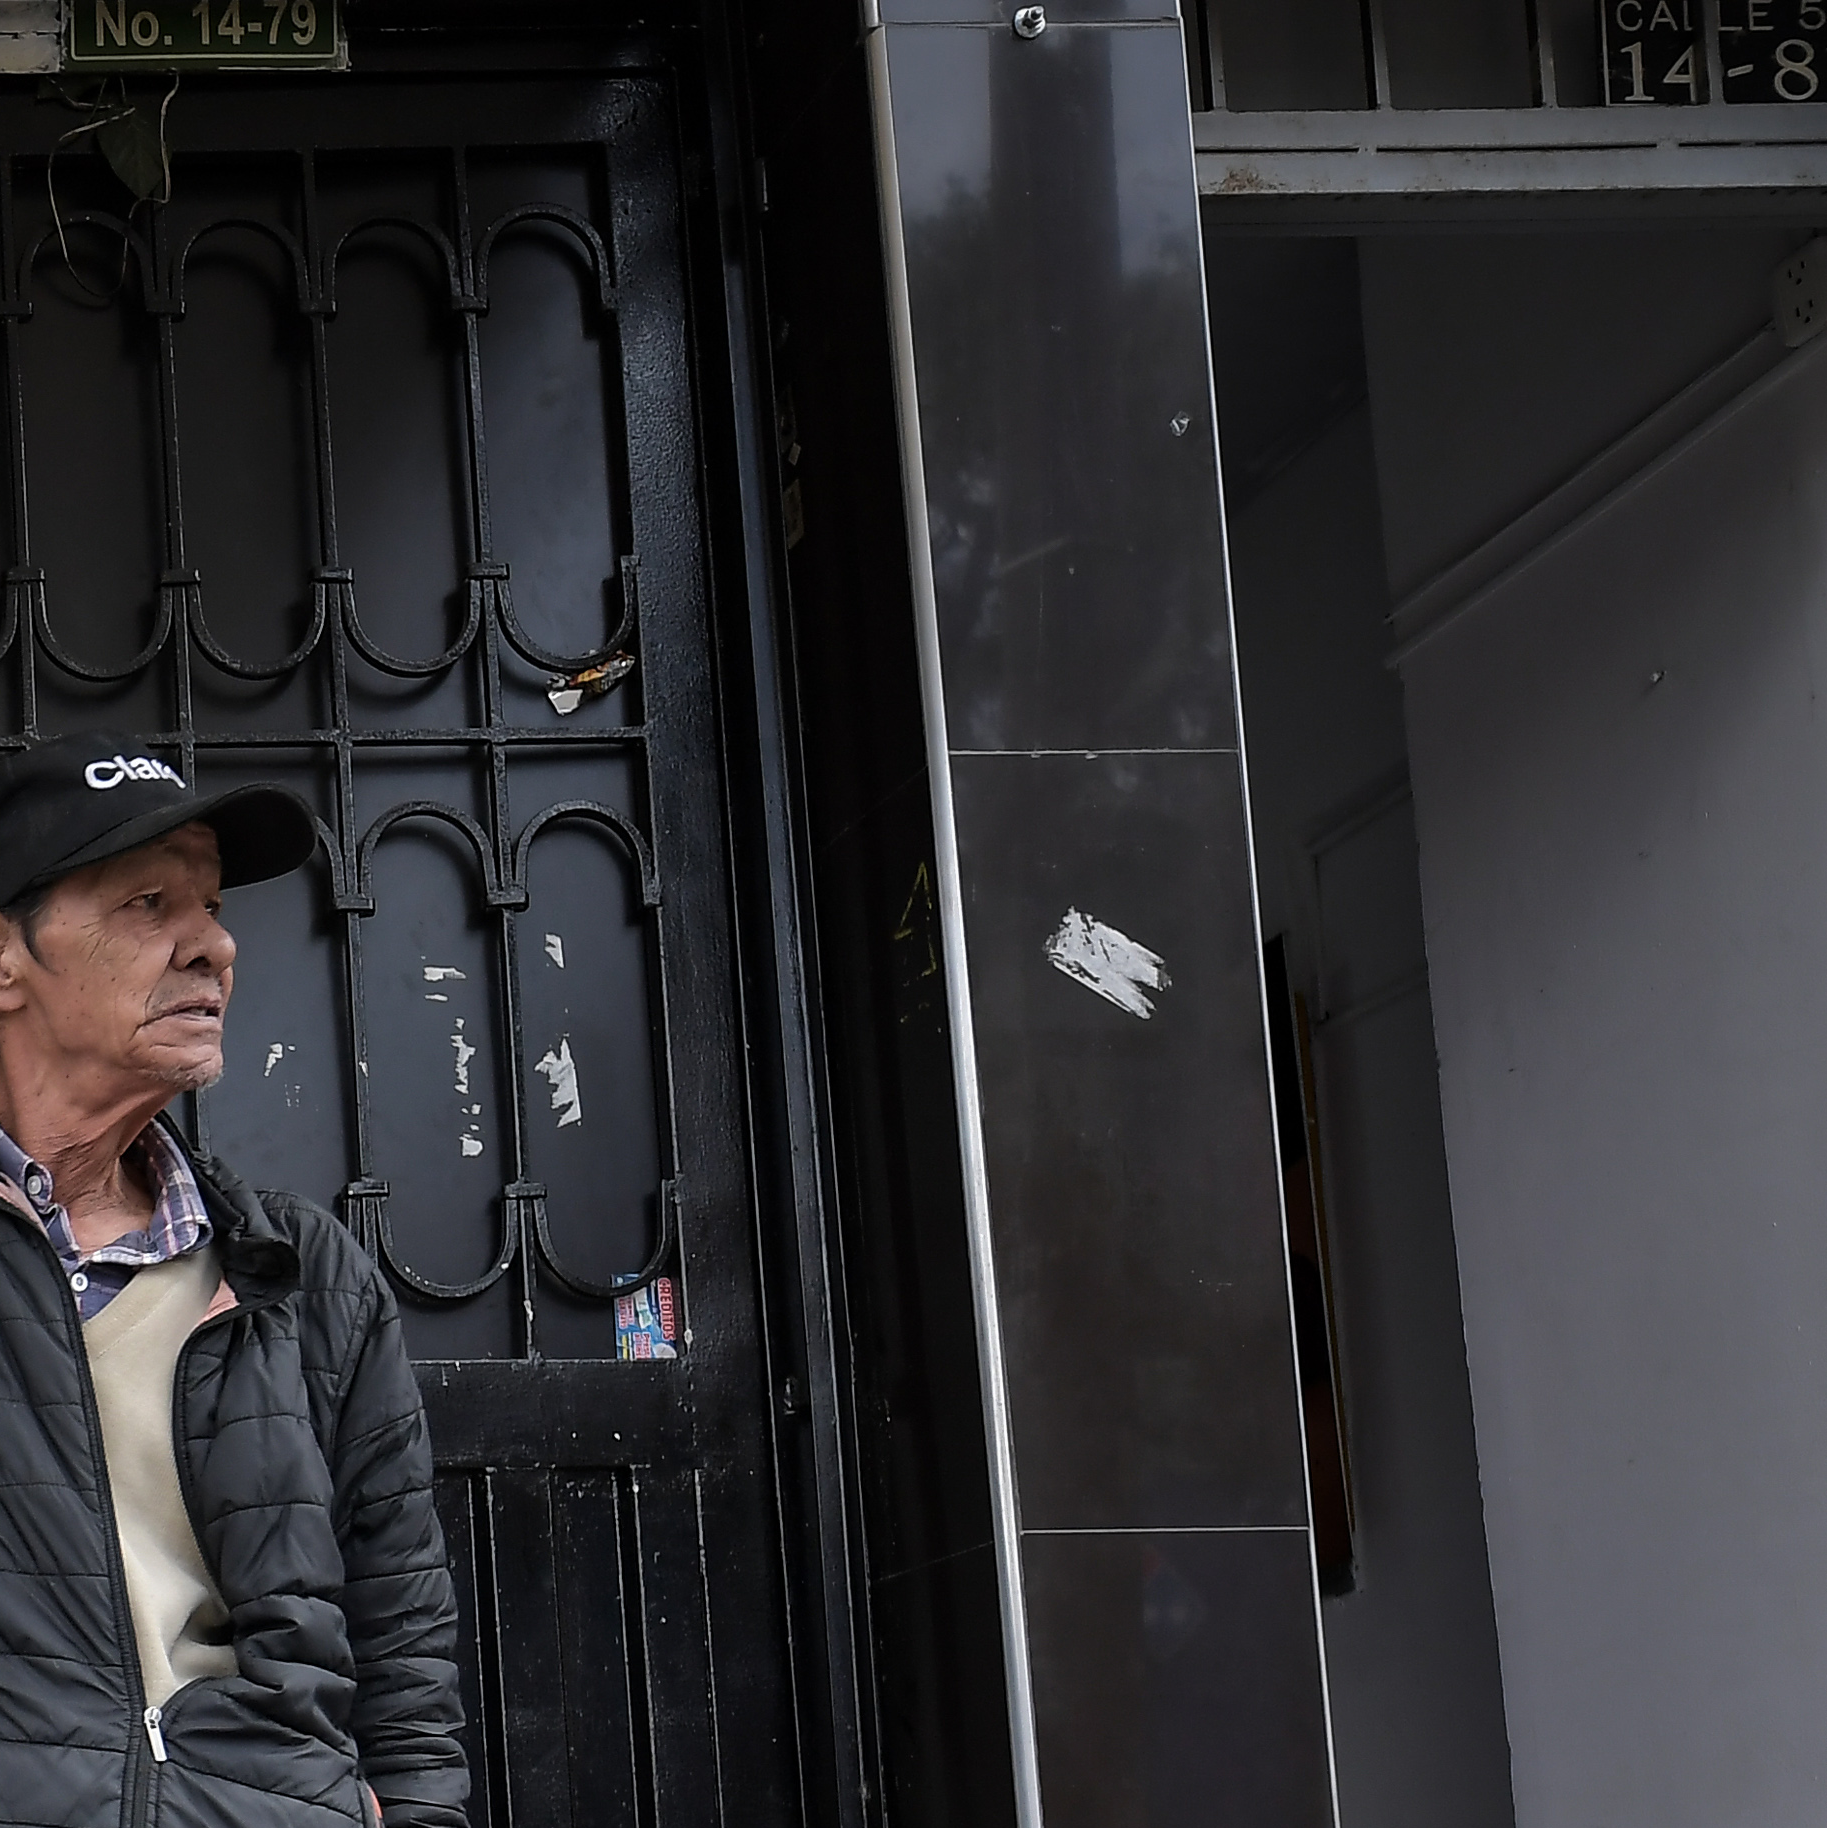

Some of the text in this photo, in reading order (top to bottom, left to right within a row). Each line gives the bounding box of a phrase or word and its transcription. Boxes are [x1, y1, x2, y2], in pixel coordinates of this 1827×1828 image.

[95, 0, 316, 46] No. 14-79
[658, 1278, 676, 1341] CREDITOS
